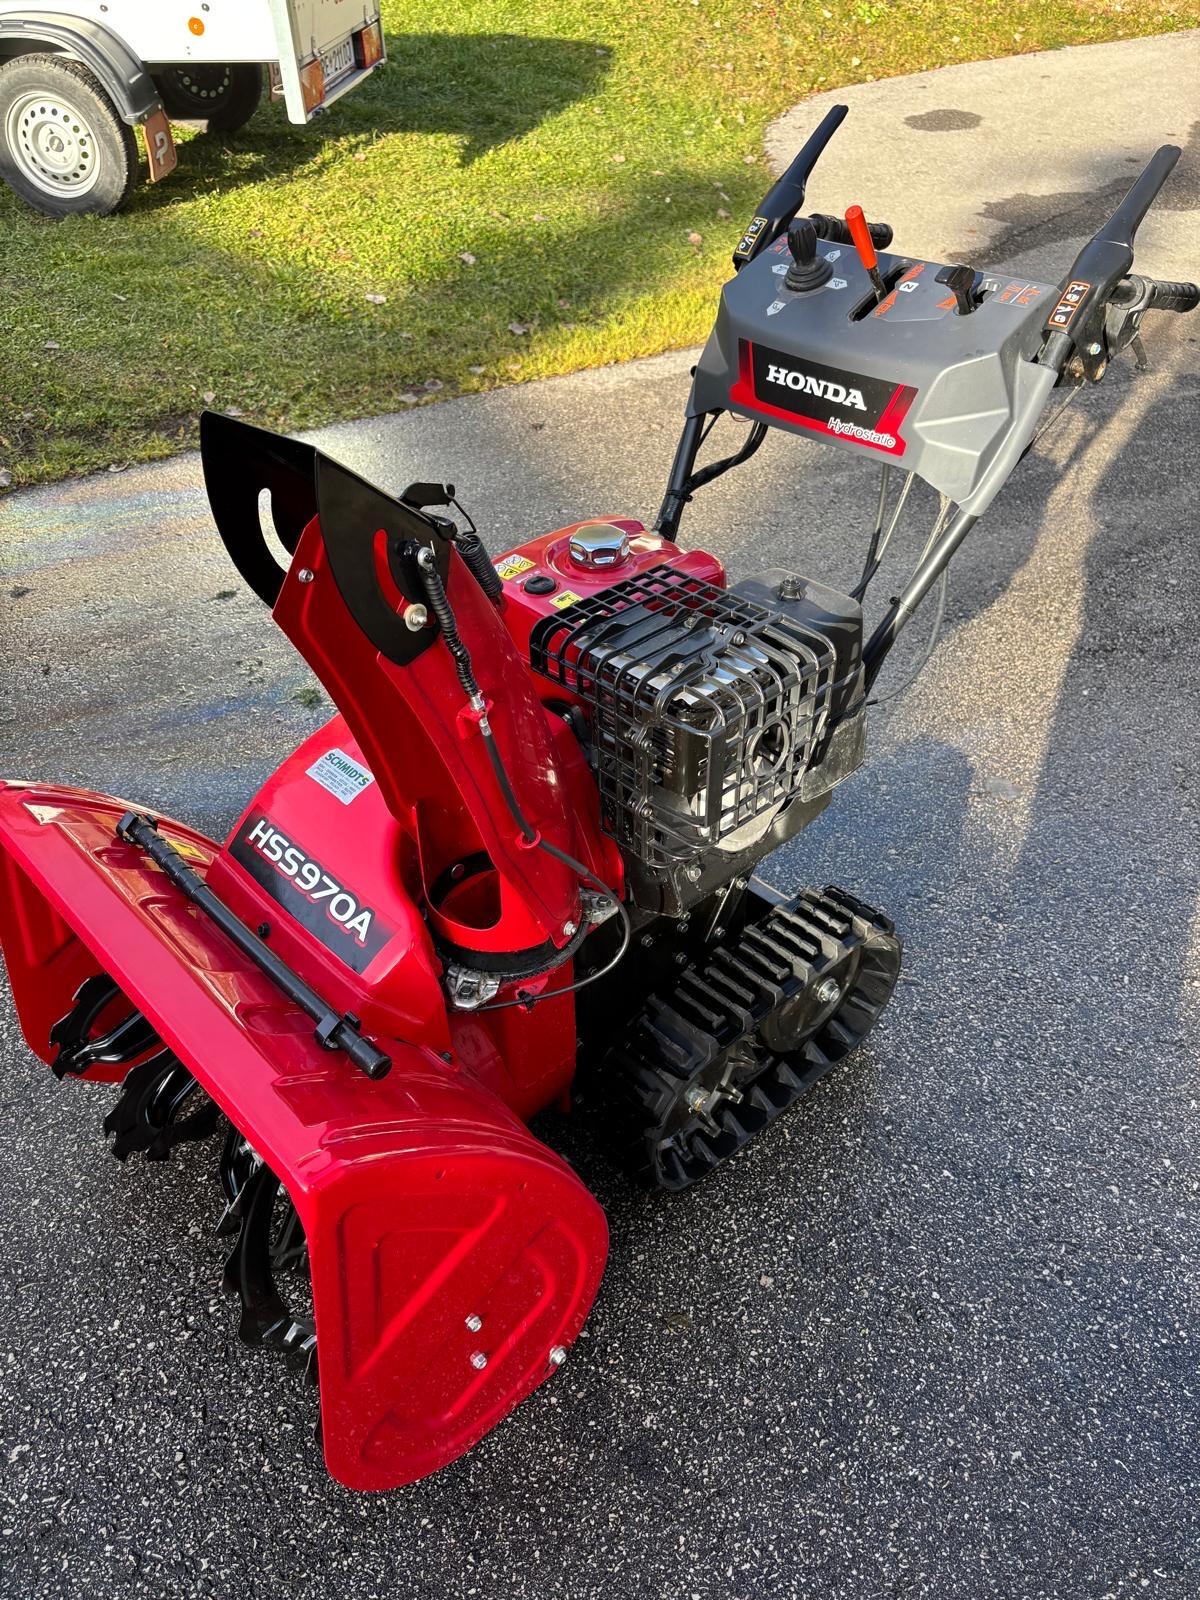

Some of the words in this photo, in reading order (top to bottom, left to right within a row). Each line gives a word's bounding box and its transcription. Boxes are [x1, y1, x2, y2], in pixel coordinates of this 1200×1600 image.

[766, 364, 867, 411] HONDA
[827, 416, 896, 448] Hydrostatic
[324, 752, 369, 786] SCHMIDTS
[248, 819, 372, 942] HSS970A
